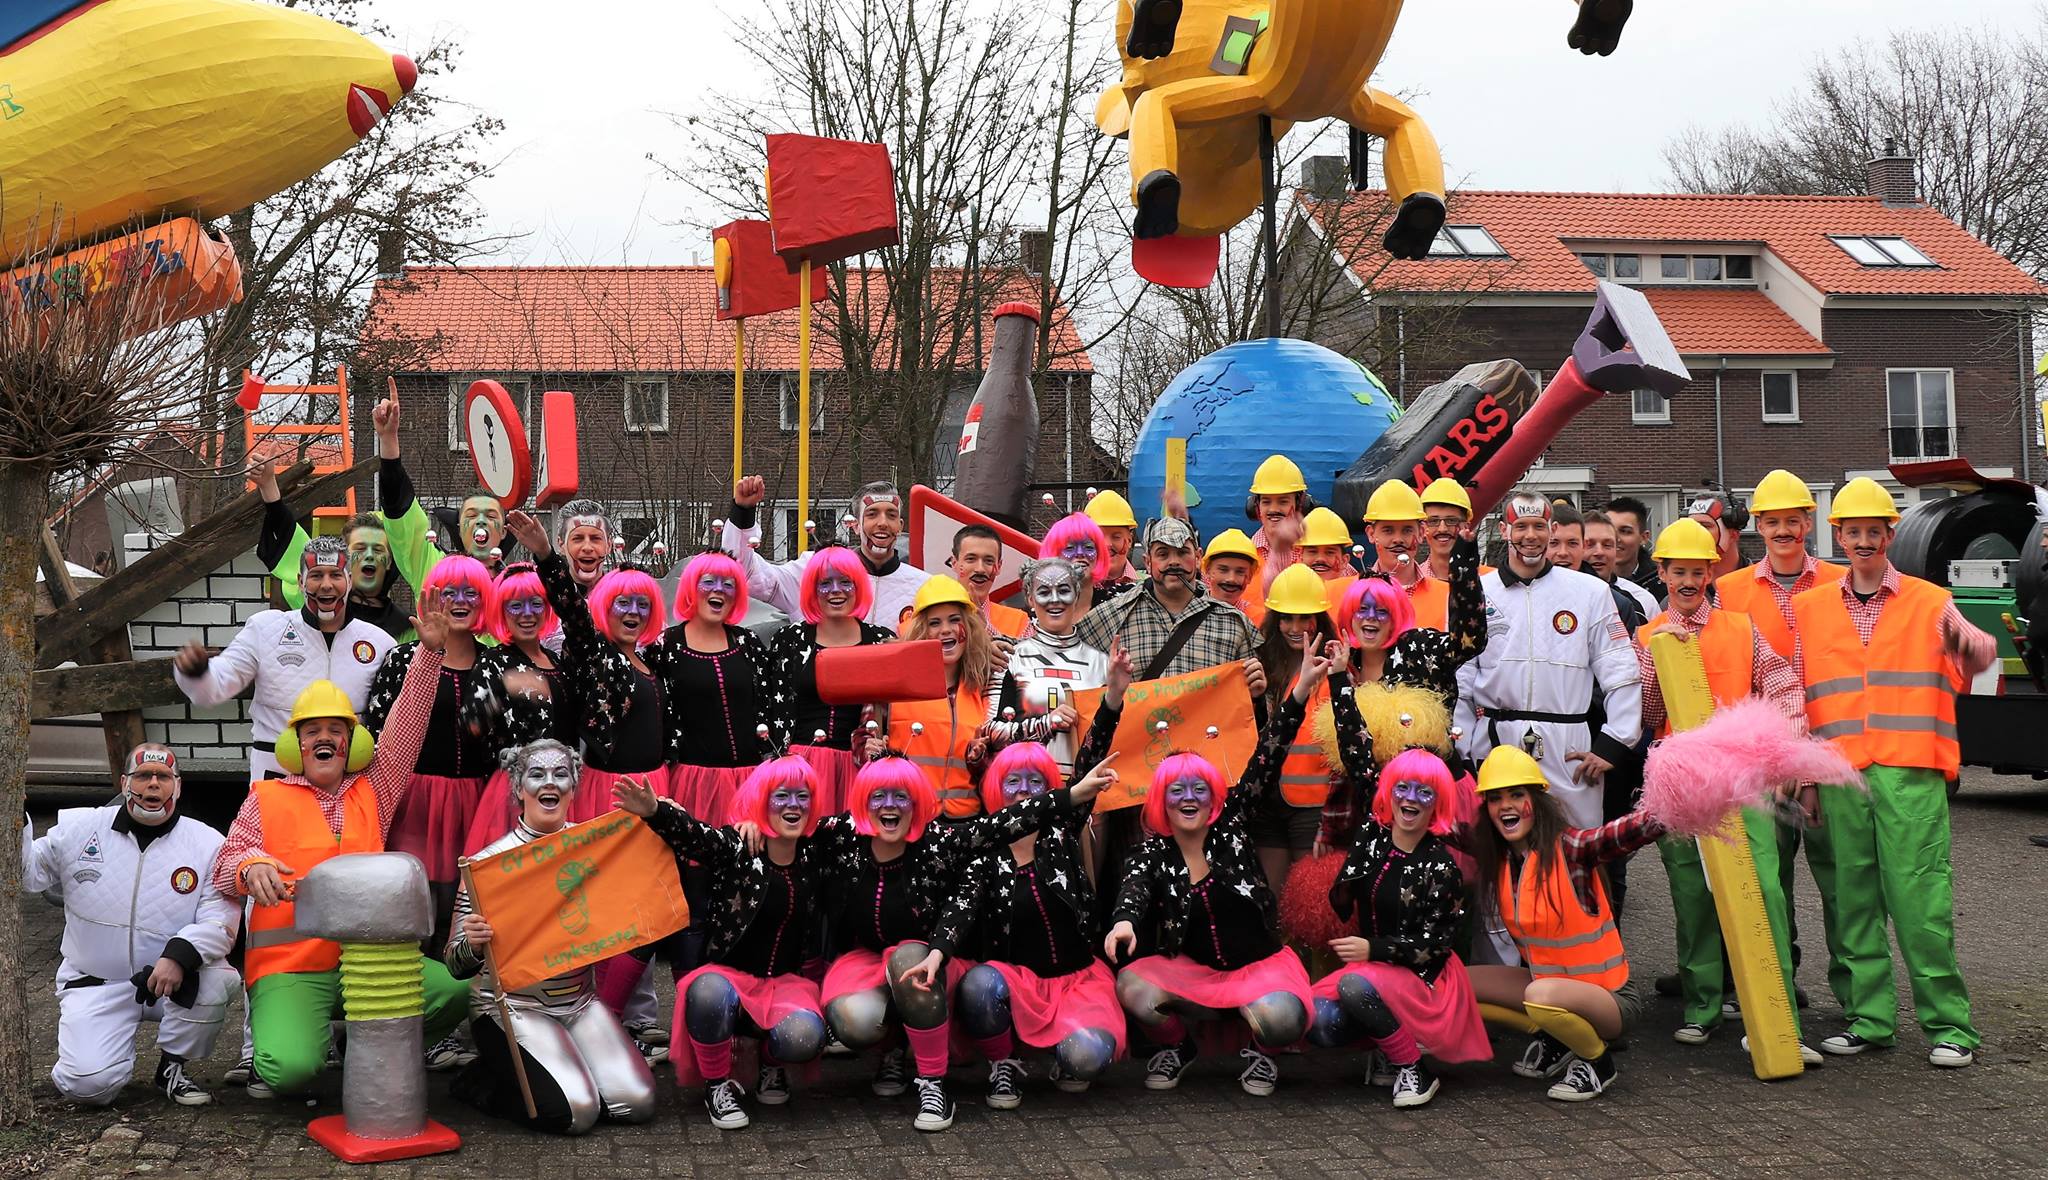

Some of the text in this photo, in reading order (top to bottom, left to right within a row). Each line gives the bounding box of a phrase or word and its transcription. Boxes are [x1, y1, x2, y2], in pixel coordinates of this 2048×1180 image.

[1518, 505, 1541, 514] NASA
[1127, 674, 1219, 703] De Prutsers
[145, 753, 165, 761] NASA
[499, 815, 634, 873] CV De Prutsers
[543, 922, 639, 968] Luyksgestel
